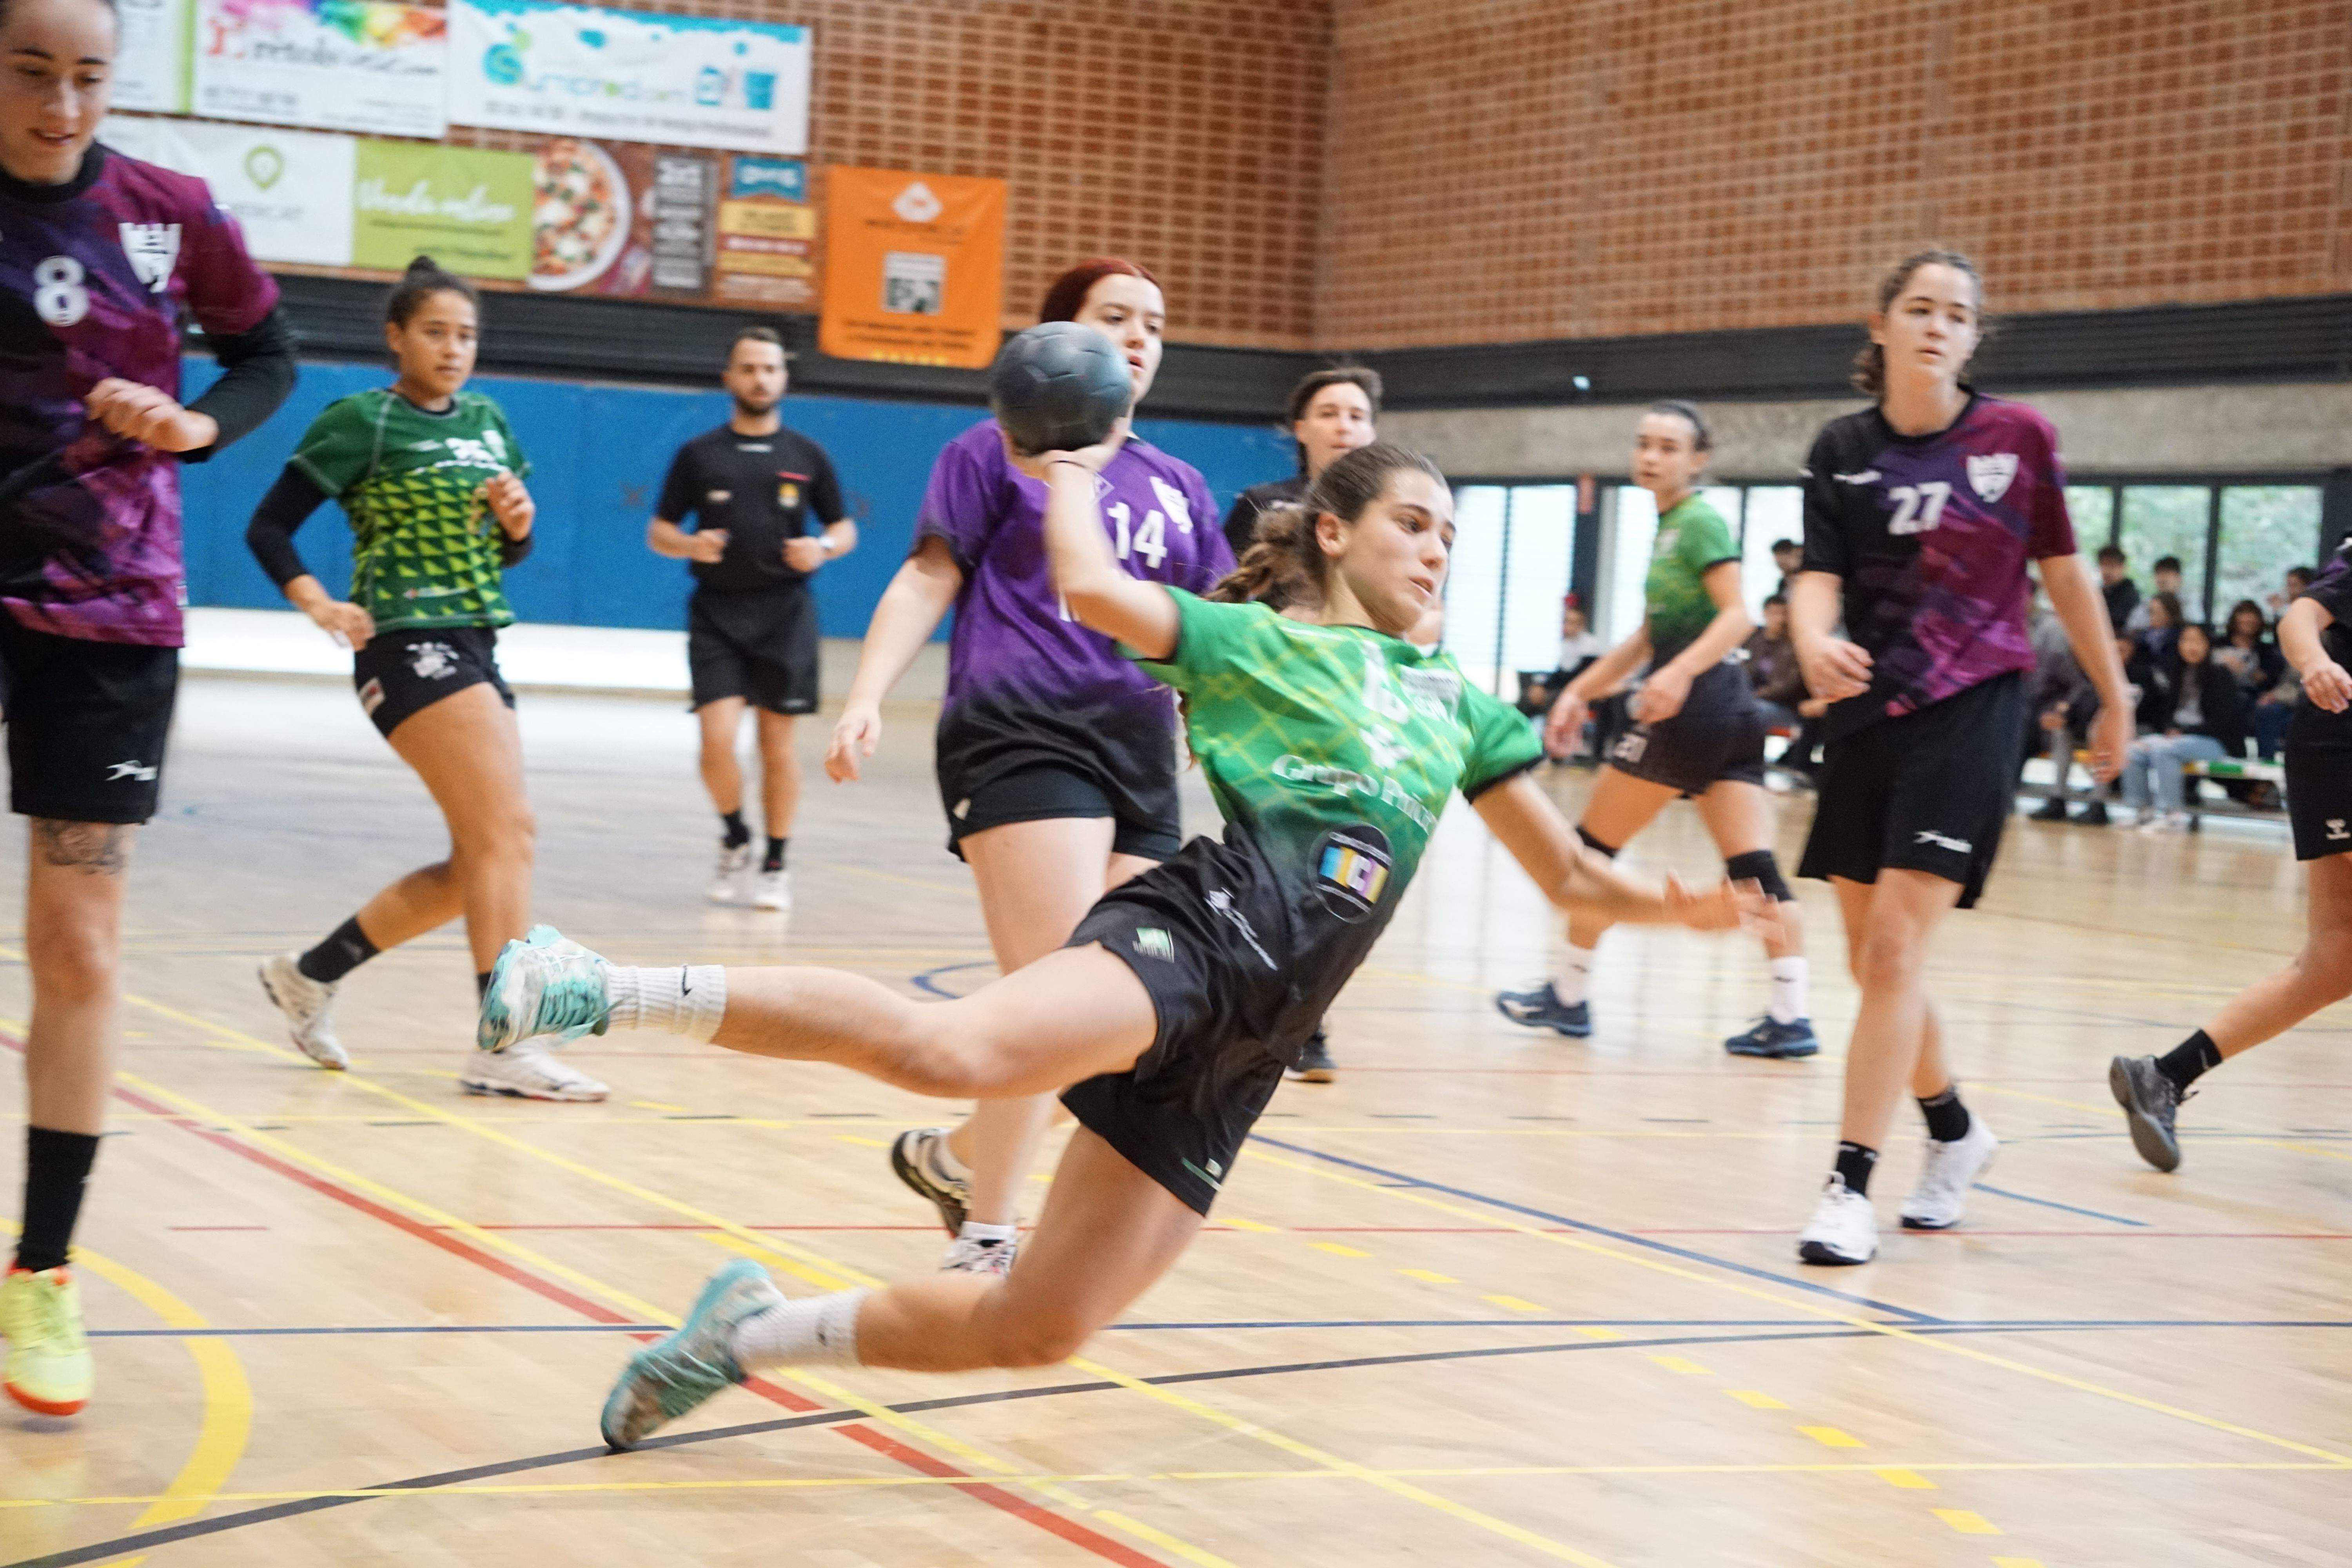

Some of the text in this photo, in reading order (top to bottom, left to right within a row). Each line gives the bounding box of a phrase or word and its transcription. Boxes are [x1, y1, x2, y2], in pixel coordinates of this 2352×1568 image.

[34, 255, 90, 326] 8
[1107, 502, 1168, 569] 14
[1888, 481, 1953, 535] 27
